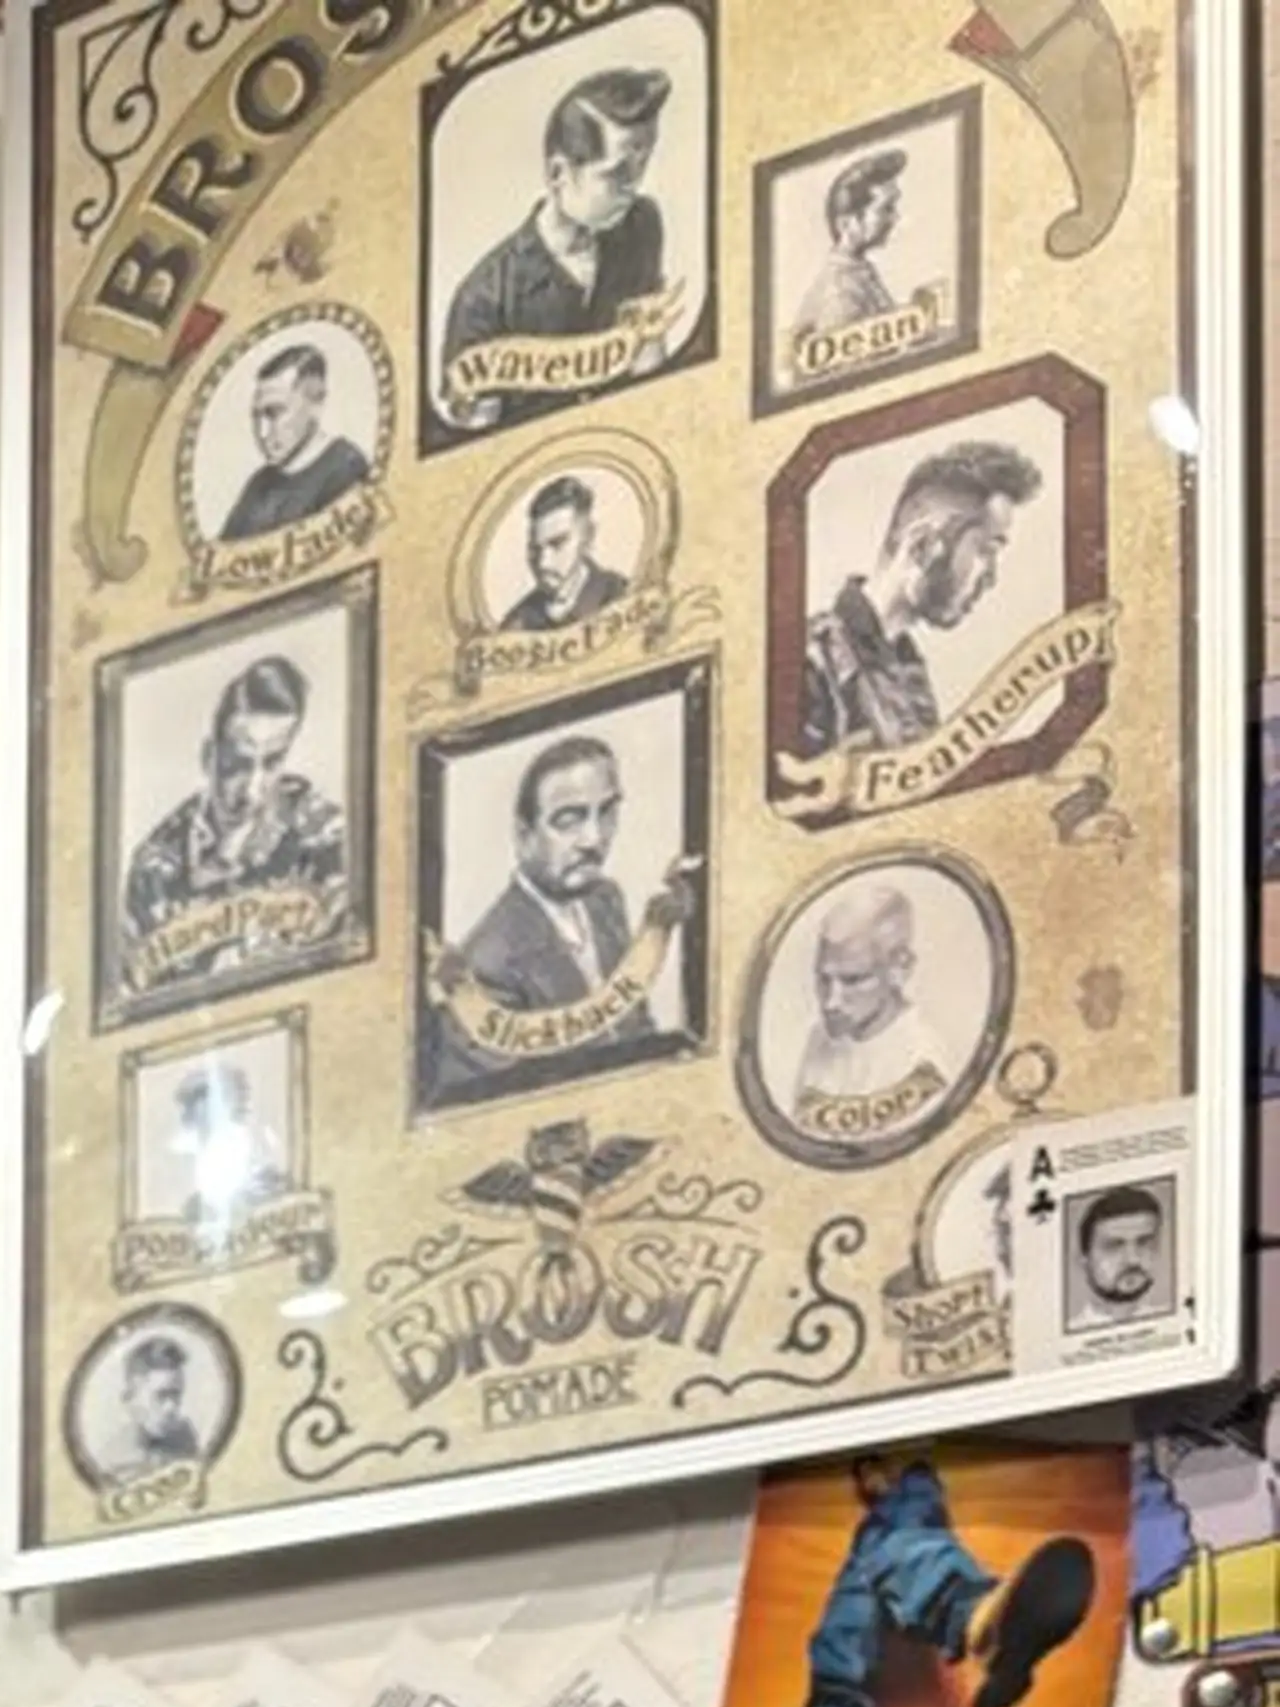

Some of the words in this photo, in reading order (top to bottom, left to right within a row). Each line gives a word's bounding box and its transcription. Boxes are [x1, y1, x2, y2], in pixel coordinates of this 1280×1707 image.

[95, 0, 444, 326] BROS
[456, 335, 627, 388] Waveup
[802, 311, 922, 371] Dean
[1031, 1146, 1054, 1181] A
